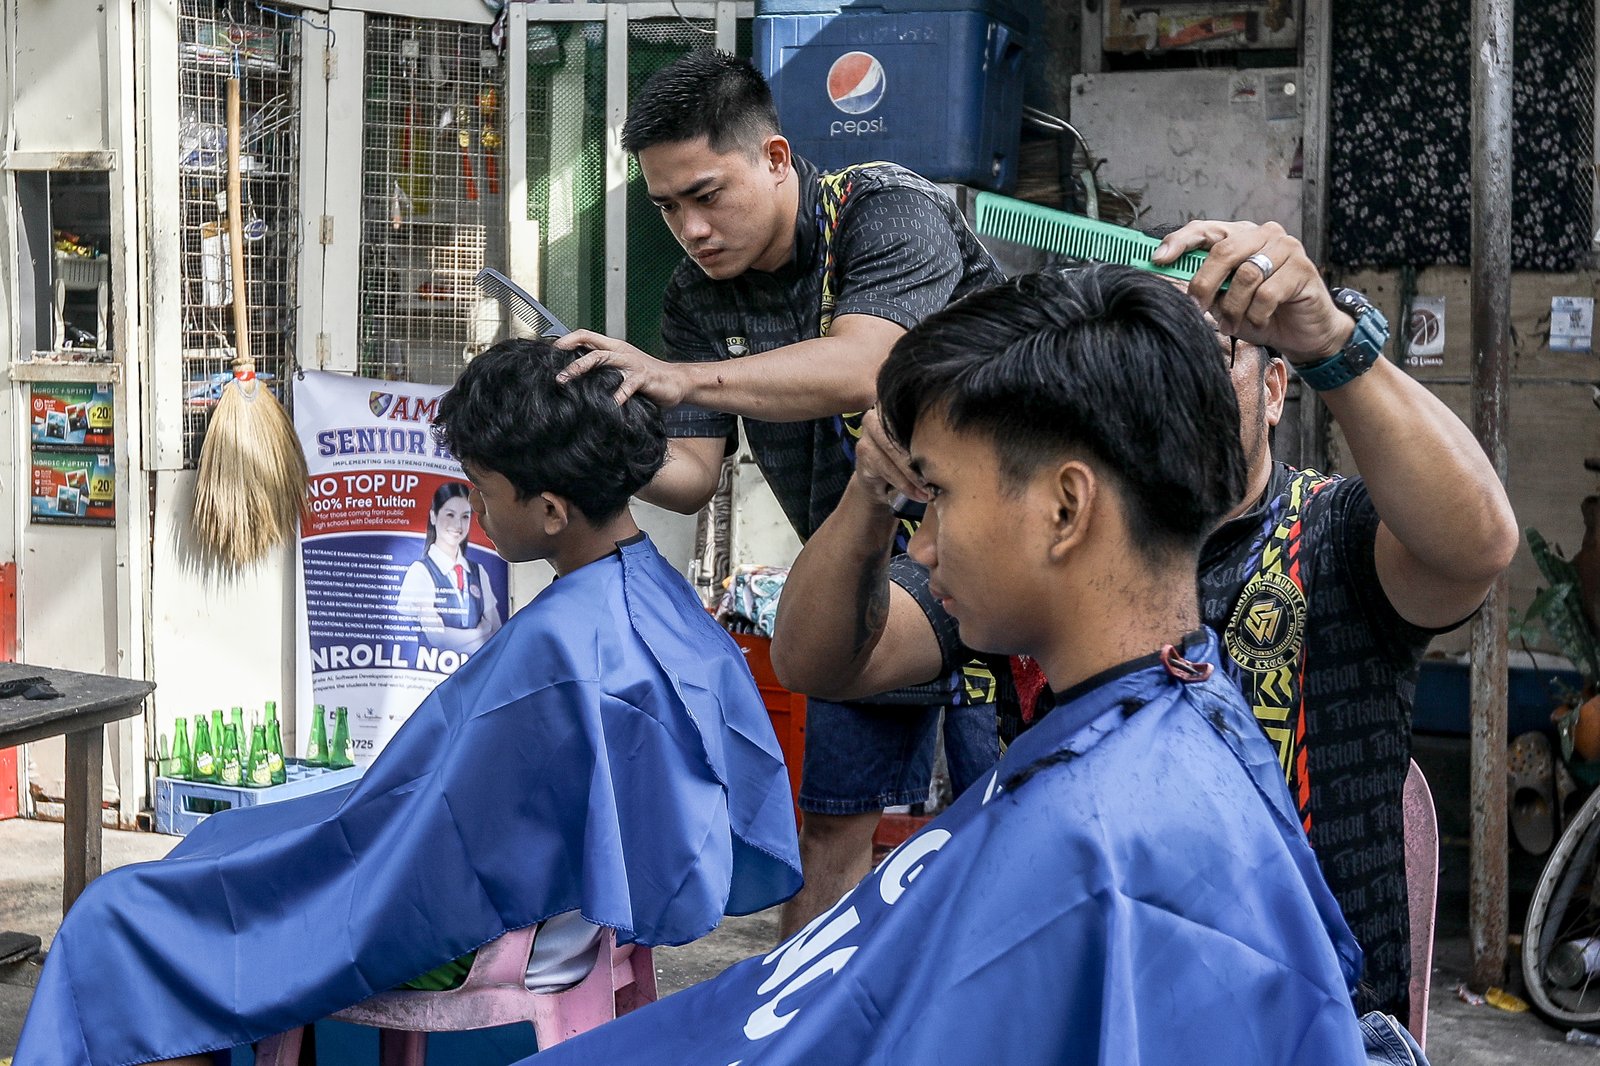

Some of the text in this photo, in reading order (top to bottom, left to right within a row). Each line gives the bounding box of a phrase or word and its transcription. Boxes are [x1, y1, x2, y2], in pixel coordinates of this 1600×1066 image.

[831, 117, 884, 136] pepsi
[387, 395, 439, 423] AM
[317, 426, 427, 456] SENIOR
[332, 459, 381, 467] IMPLEMENTING
[397, 459, 447, 470] STRENGTHENED
[306, 474, 419, 498] NO TOP UP
[345, 497, 372, 508] Free
[375, 495, 416, 508] Tuition
[312, 517, 410, 530] high schools with DepEd vouchers
[330, 510, 347, 518] those
[348, 510, 370, 518] coming
[386, 509, 404, 517] public
[1263, 572, 1303, 603] MMUNITY
[312, 644, 408, 669] NROLL
